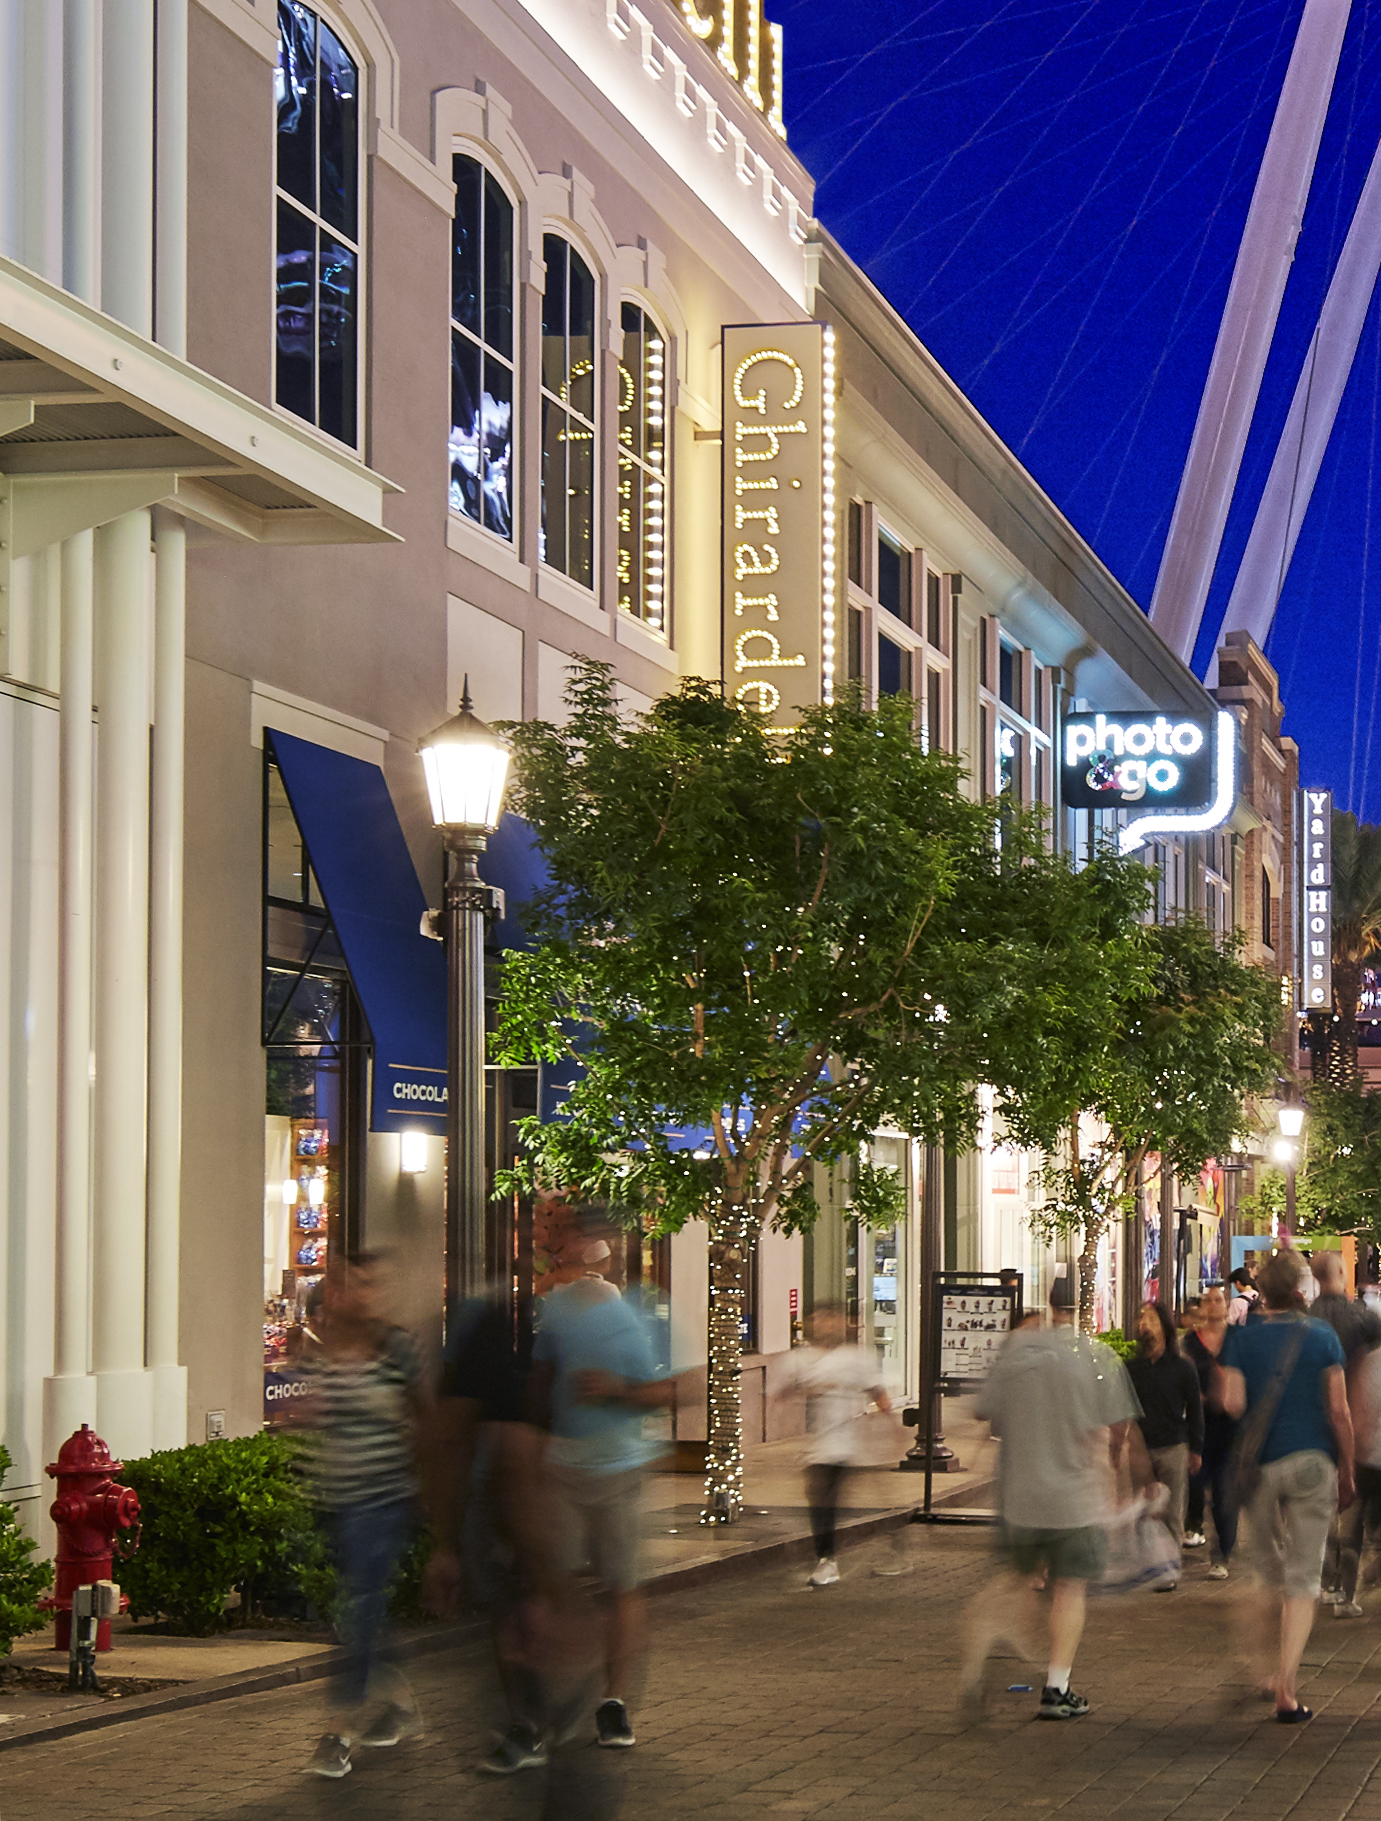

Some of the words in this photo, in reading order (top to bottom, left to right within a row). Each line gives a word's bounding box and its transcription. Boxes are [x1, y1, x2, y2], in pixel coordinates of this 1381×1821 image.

[1066, 713, 1205, 767] photo
[1307, 791, 1329, 886] Yard
[1307, 890, 1329, 1004] House
[393, 1082, 449, 1103] CHOCOLA
[266, 1381, 314, 1401] CHOCO
